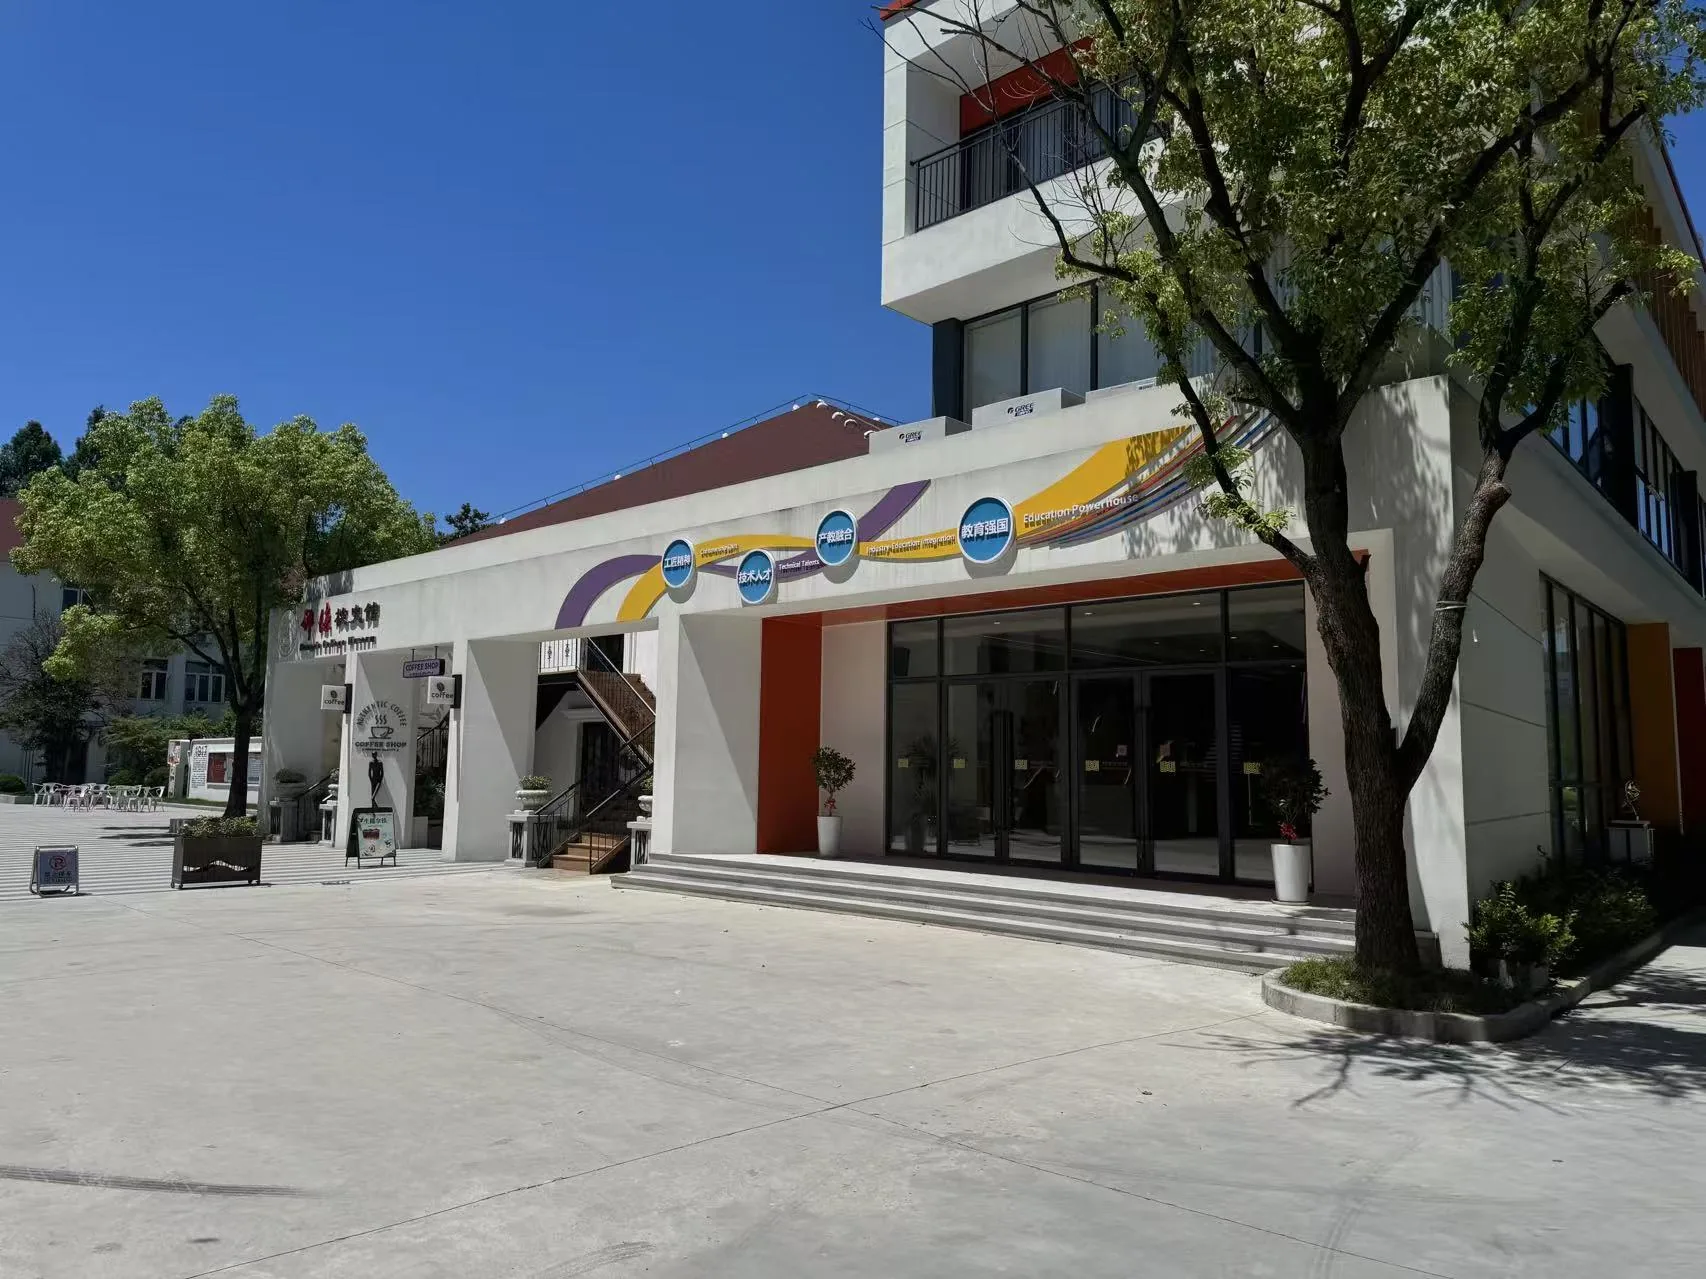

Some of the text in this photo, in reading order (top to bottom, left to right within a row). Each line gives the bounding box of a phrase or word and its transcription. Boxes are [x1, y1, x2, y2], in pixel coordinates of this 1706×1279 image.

[1023, 494, 1139, 523] Education Powerhouse
[961, 517, 1009, 539] 教育强国
[818, 528, 853, 545] 产教融合
[664, 554, 691, 569] 工匠精神
[778, 559, 820, 571] Technical Talents
[738, 567, 772, 584] 技术人才
[405, 661, 438, 672] COFFEE SHOP
[324, 698, 345, 706] coffee
[431, 691, 454, 699] coffee
[356, 700, 407, 727] AUTHENTIC COFFEE
